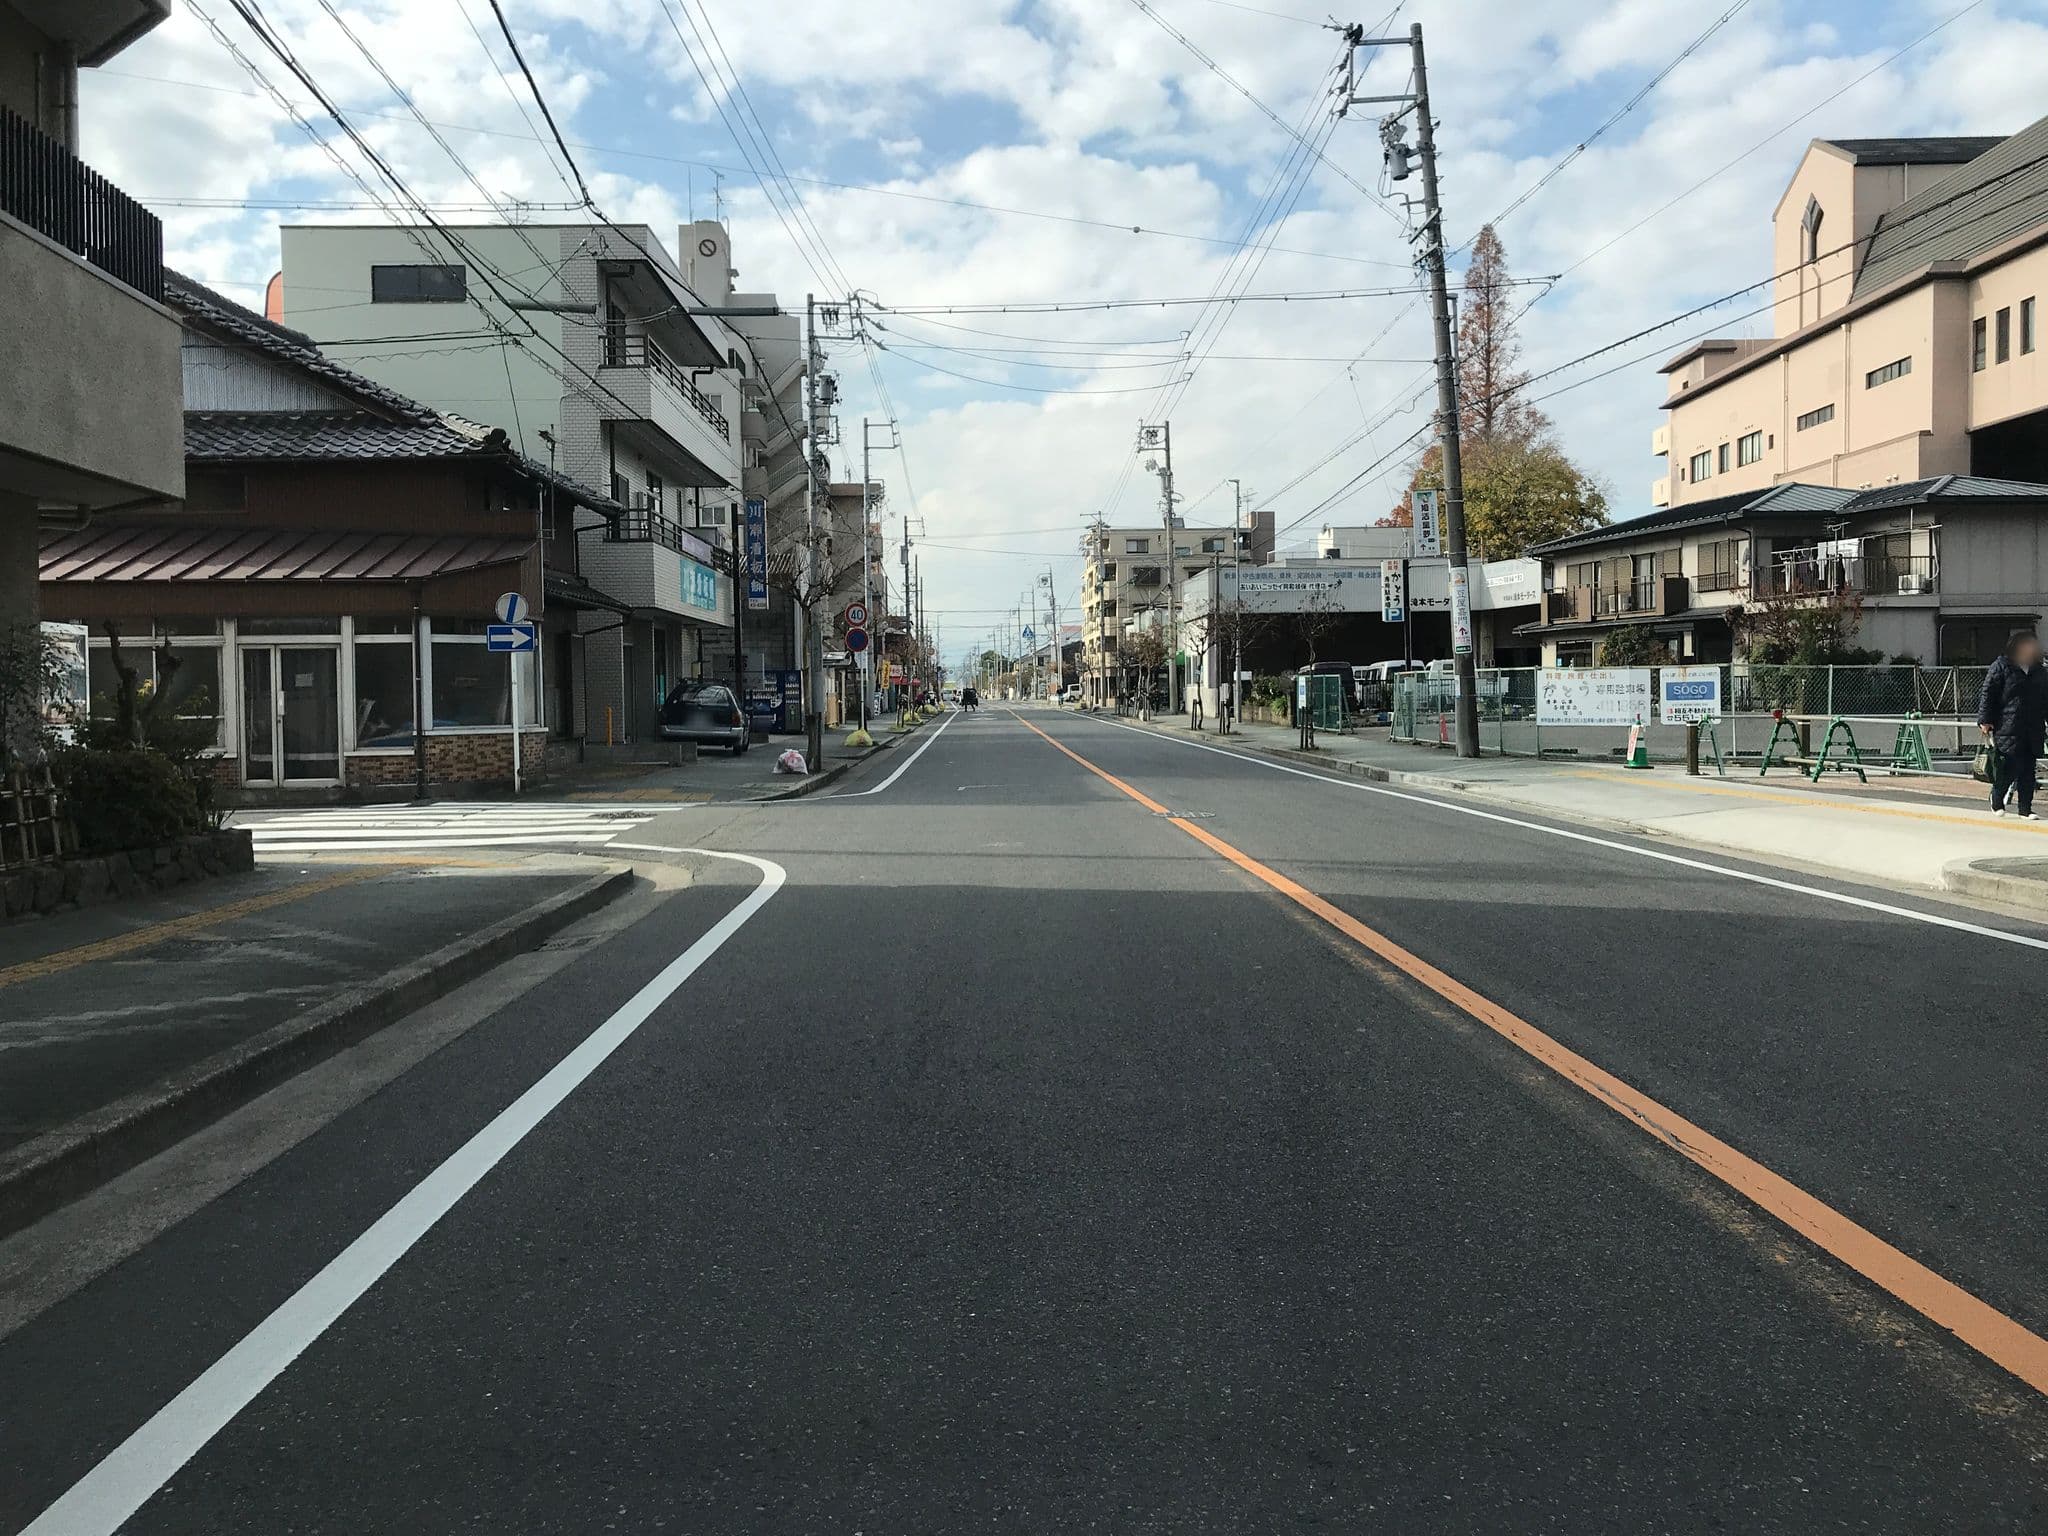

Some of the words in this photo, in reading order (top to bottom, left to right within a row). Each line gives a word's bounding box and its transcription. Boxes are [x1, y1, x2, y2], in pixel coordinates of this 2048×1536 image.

[1391, 572, 1402, 607] かとう
[850, 609, 863, 620] 40
